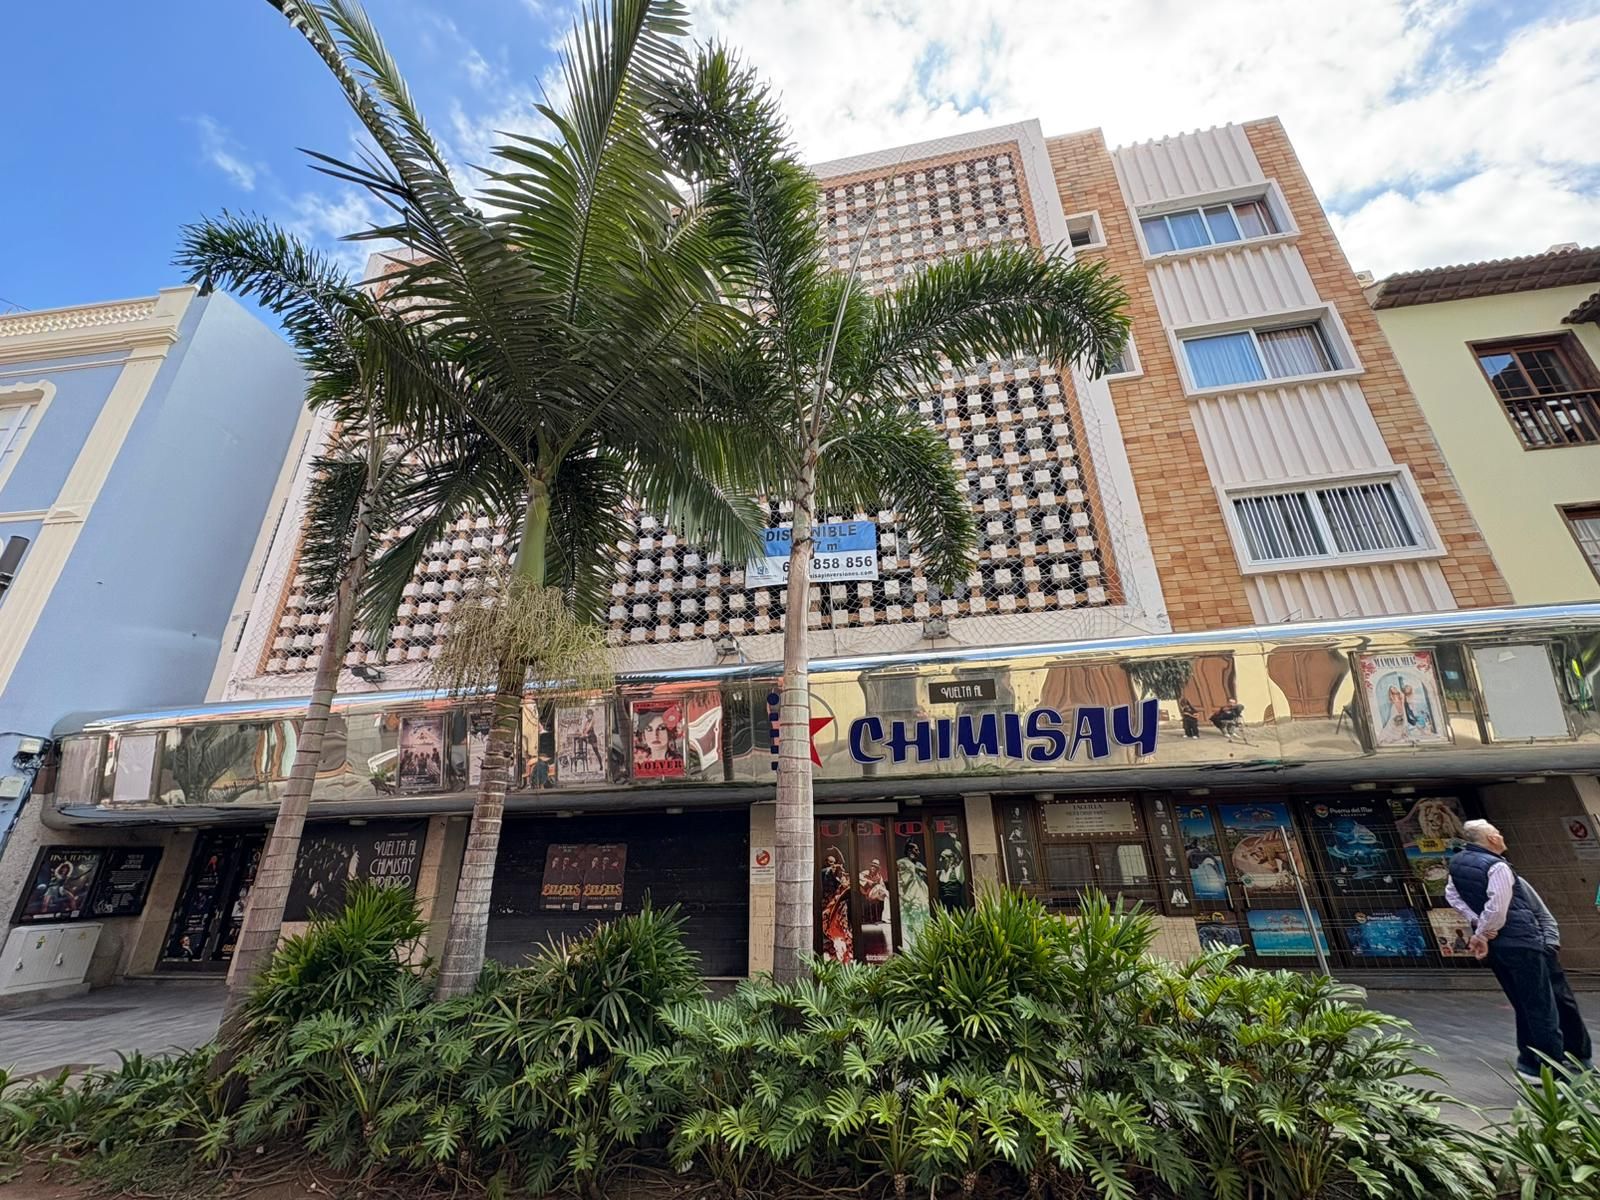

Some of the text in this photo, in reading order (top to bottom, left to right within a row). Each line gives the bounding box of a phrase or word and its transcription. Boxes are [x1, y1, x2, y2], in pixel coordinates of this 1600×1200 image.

[766, 525, 856, 542] DISNIBLE
[813, 556, 873, 569] 858 856
[1373, 656, 1417, 668] MAMMA MIA!
[940, 684, 983, 699] VUELTA AL
[848, 698, 1159, 764] CHIMISAY
[637, 760, 682, 770] VOLVER
[374, 839, 417, 857] VUELTA AL
[369, 857, 416, 875] CHIMISAY
